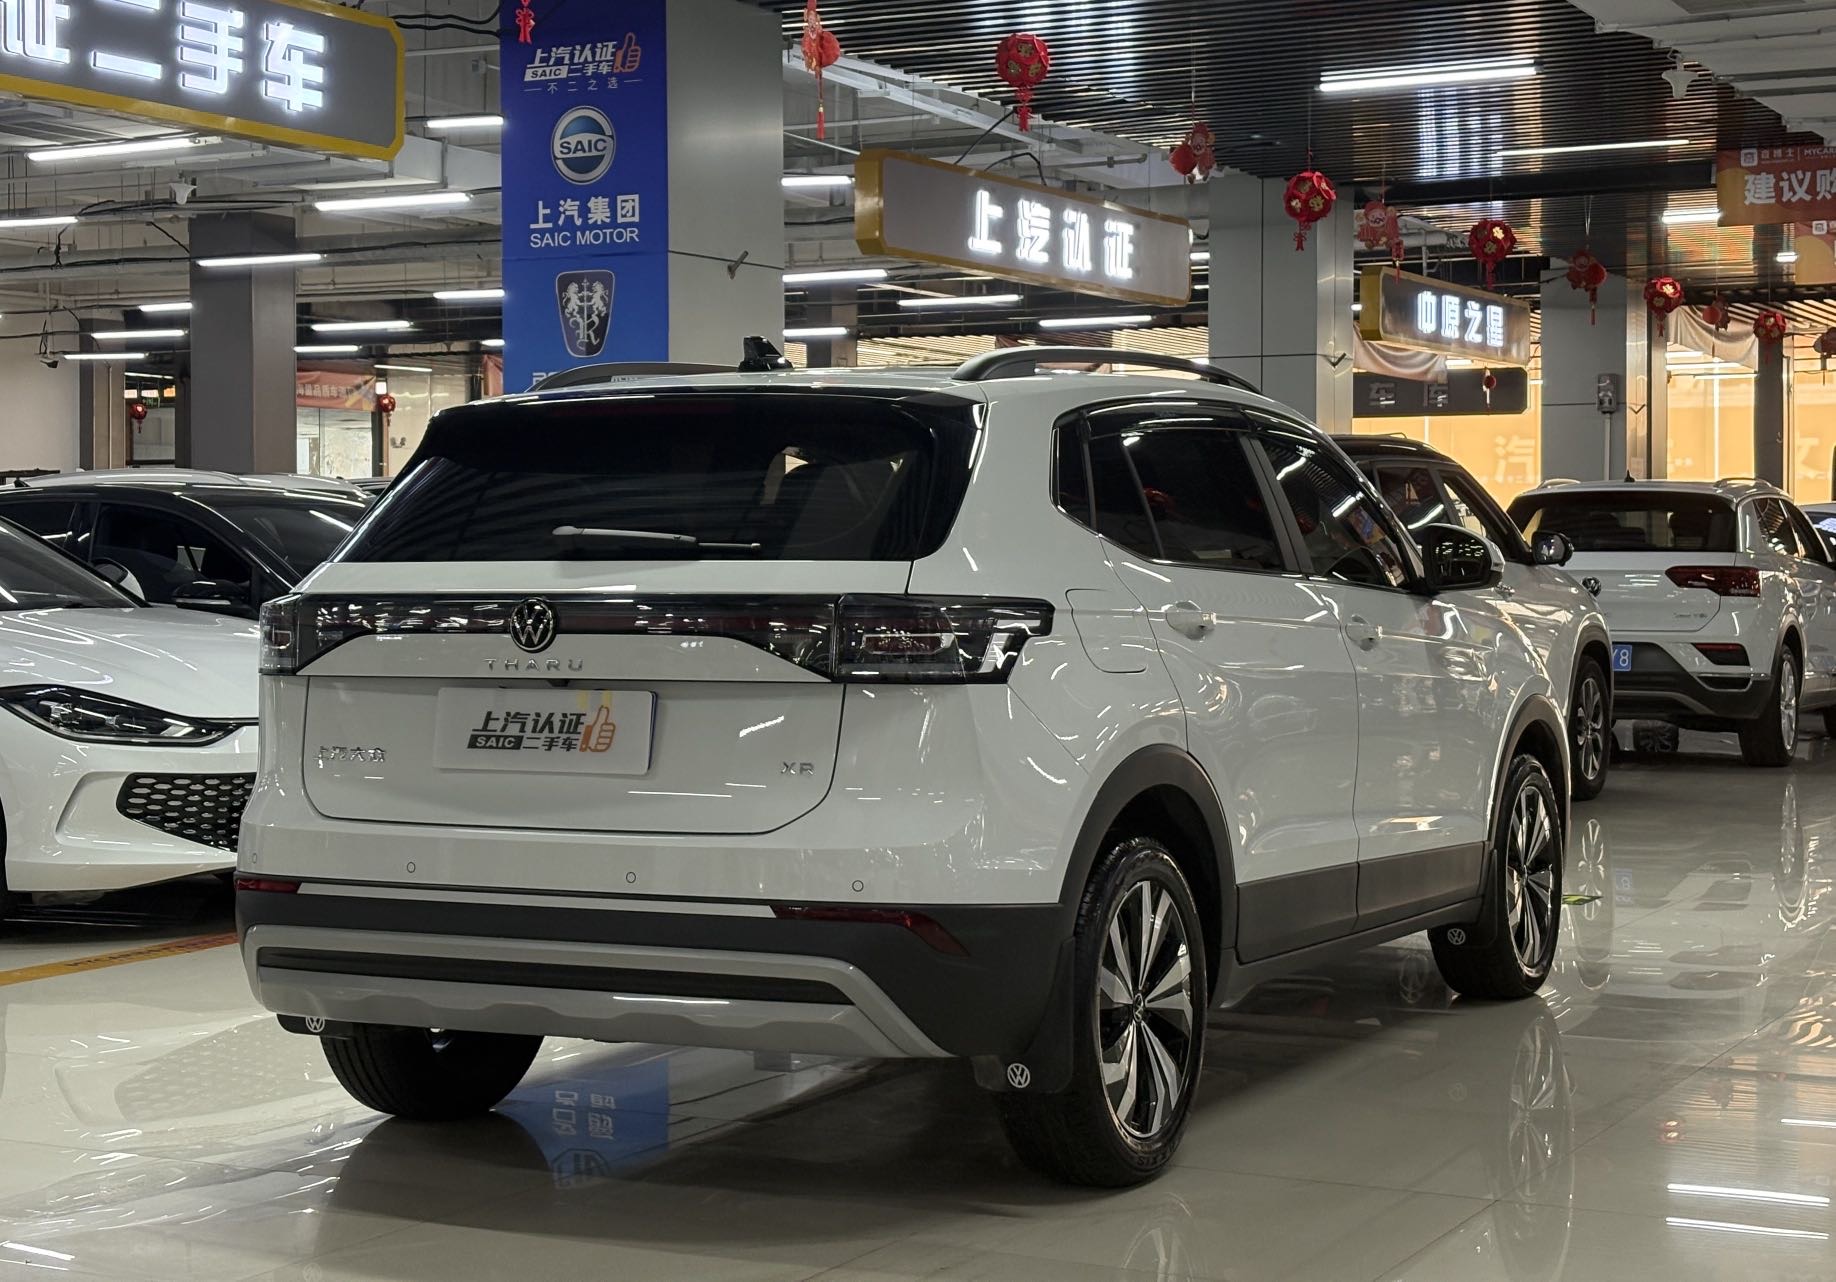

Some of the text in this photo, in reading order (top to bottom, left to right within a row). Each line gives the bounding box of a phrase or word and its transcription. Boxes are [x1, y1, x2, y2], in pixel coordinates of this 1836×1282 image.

[0, 0, 324, 112] 证二手车
[527, 41, 617, 67] 上汽认证
[530, 61, 613, 79] SAIC 二手车
[547, 77, 618, 94] 不二之选
[559, 138, 608, 155] SAIC
[530, 194, 639, 229] 上汽集团
[530, 228, 640, 248] SAIC MOTOR
[968, 189, 1135, 280] 上汽认证
[1417, 290, 1504, 347] 中原之星
[484, 658, 583, 671] THARU
[472, 710, 587, 735] 上汽认证
[475, 735, 580, 751] SAIC 二手车
[781, 761, 814, 775] XR
